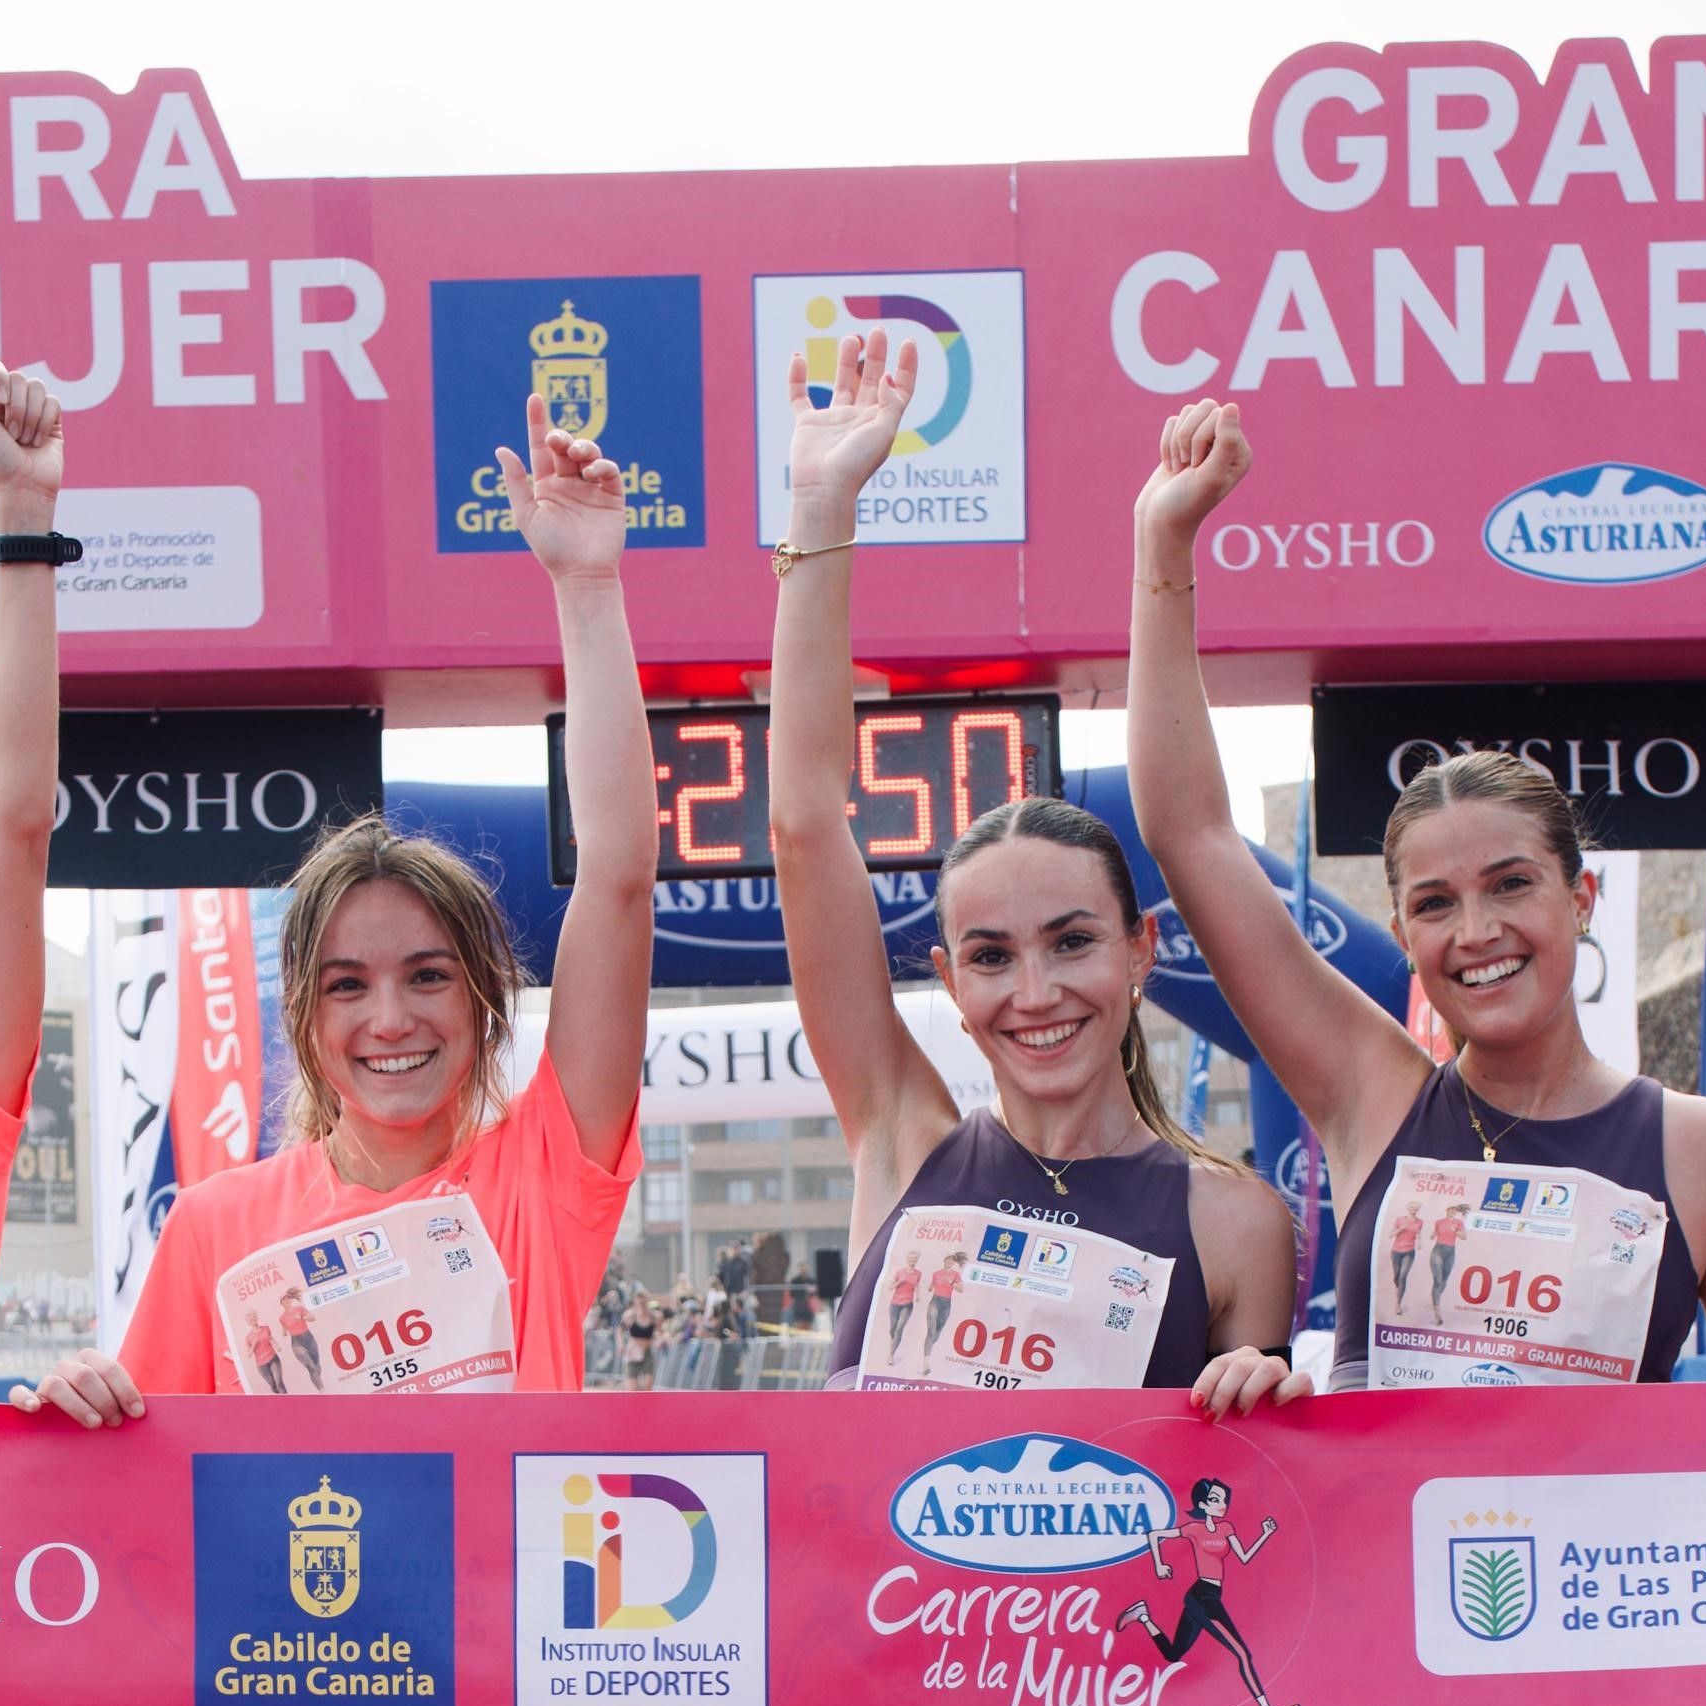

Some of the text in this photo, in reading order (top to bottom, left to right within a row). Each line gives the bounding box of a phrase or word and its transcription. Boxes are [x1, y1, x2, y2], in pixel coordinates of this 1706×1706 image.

[905, 461, 999, 489] INSULAR
[456, 502, 516, 534] Gra
[1211, 519, 1435, 572] OYSHO
[72, 577, 117, 593] Gran
[121, 575, 188, 592] Canaria
[1415, 1180, 1466, 1198] SUMA
[996, 1198, 1080, 1227] OYSHO
[915, 1226, 963, 1243] SUMA
[237, 1271, 285, 1302] SUMA
[1460, 1265, 1563, 1314] 016
[331, 1308, 433, 1371] 016
[1483, 1316, 1528, 1338] 1906
[953, 1318, 1056, 1373] 016
[1381, 1330, 1623, 1377] CARRERA DE LA MUJER GRAN CANARIA
[369, 1358, 419, 1388] 3155
[428, 1367, 463, 1387] GRAN
[973, 1371, 1021, 1390] 1907
[1392, 1366, 1434, 1382] OYSHO
[956, 1482, 1146, 1496] CENTRAL LECHERA
[912, 1486, 1155, 1537] ASTURIANA
[1561, 1573, 1599, 1599] de
[1619, 1573, 1670, 1597] Las
[867, 1565, 1102, 1637] Carrera
[1562, 1605, 1599, 1630] de
[1607, 1605, 1680, 1629] Gran
[229, 1632, 411, 1663] Cabildo de
[540, 1636, 740, 1662] INSTITUTO INSULAR
[923, 1641, 967, 1690] de
[977, 1639, 1008, 1690] la
[214, 1666, 435, 1697] Gran Canaria
[550, 1670, 731, 1696] DE DEPORTES
